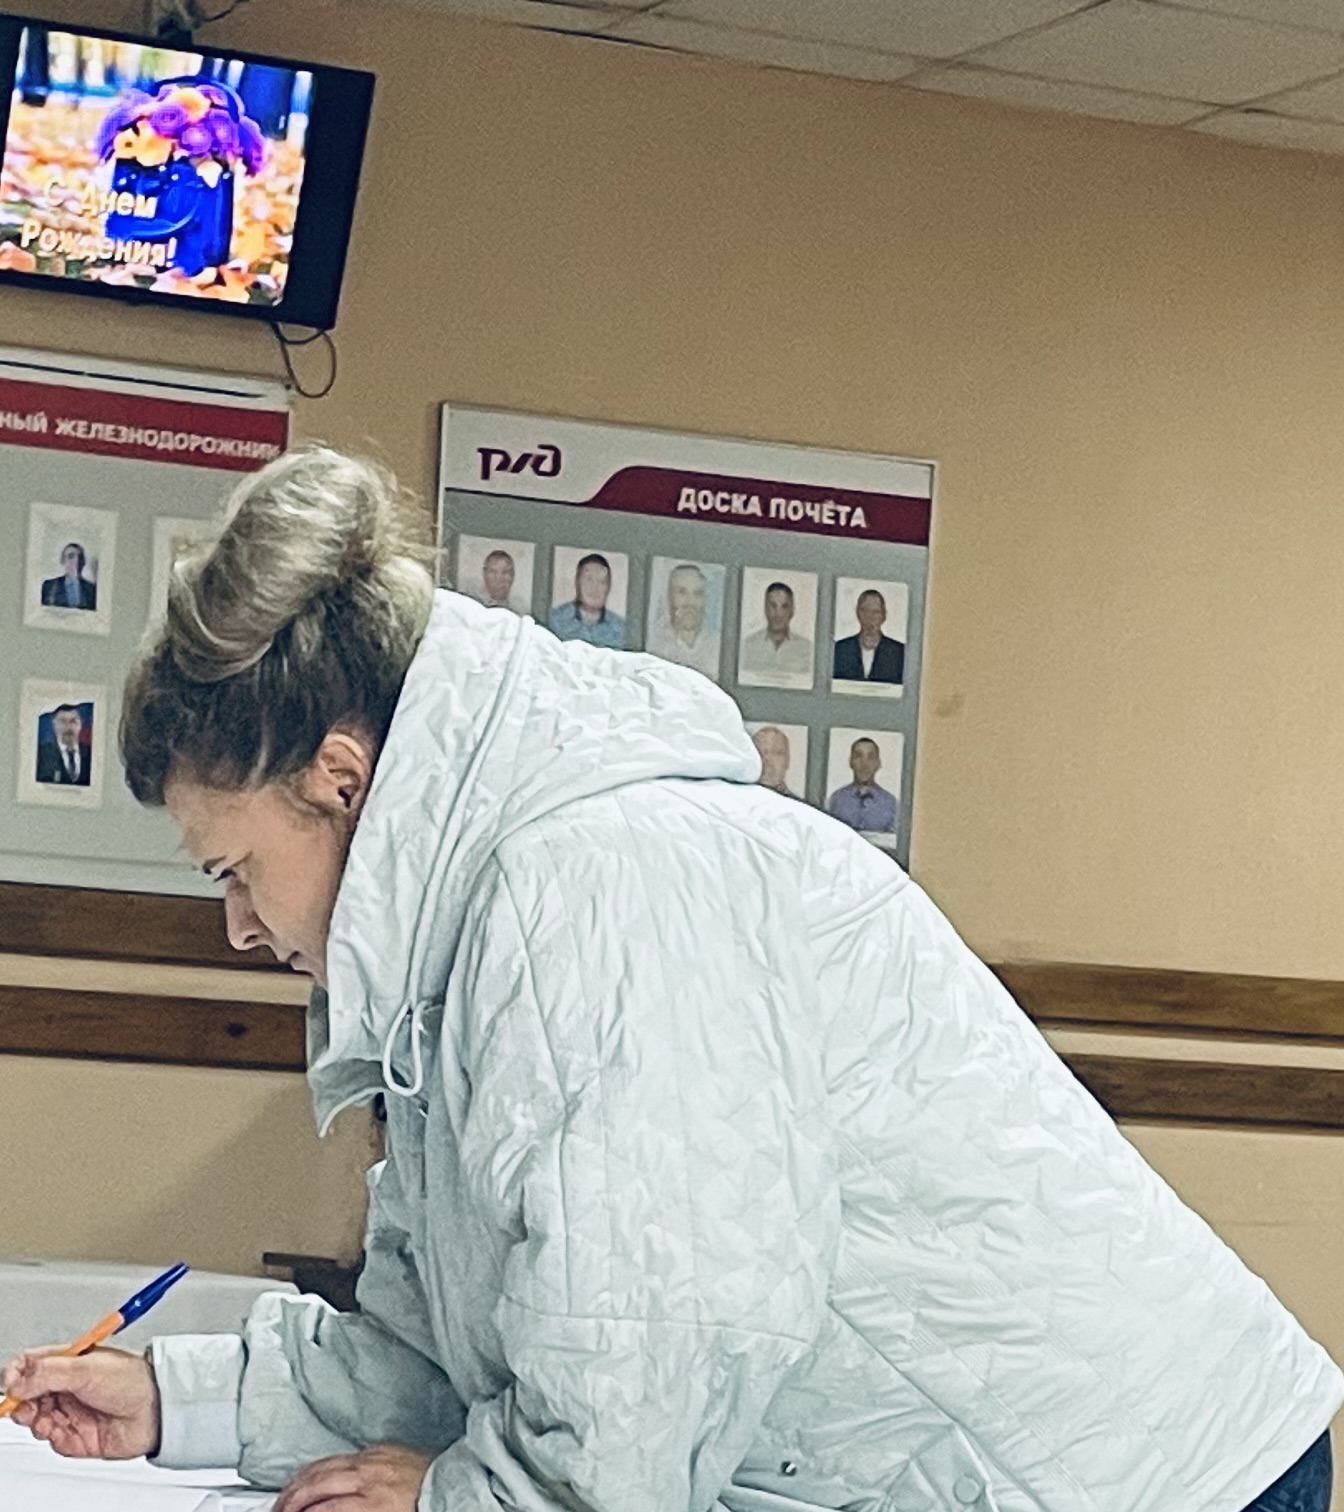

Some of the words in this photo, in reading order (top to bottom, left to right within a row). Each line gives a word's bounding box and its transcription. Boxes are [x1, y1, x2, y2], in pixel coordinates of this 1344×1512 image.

[21, 218, 178, 268] Рождения!
[677, 487, 762, 517] ДОСКА
[769, 498, 867, 528] ПОЧЁТА
